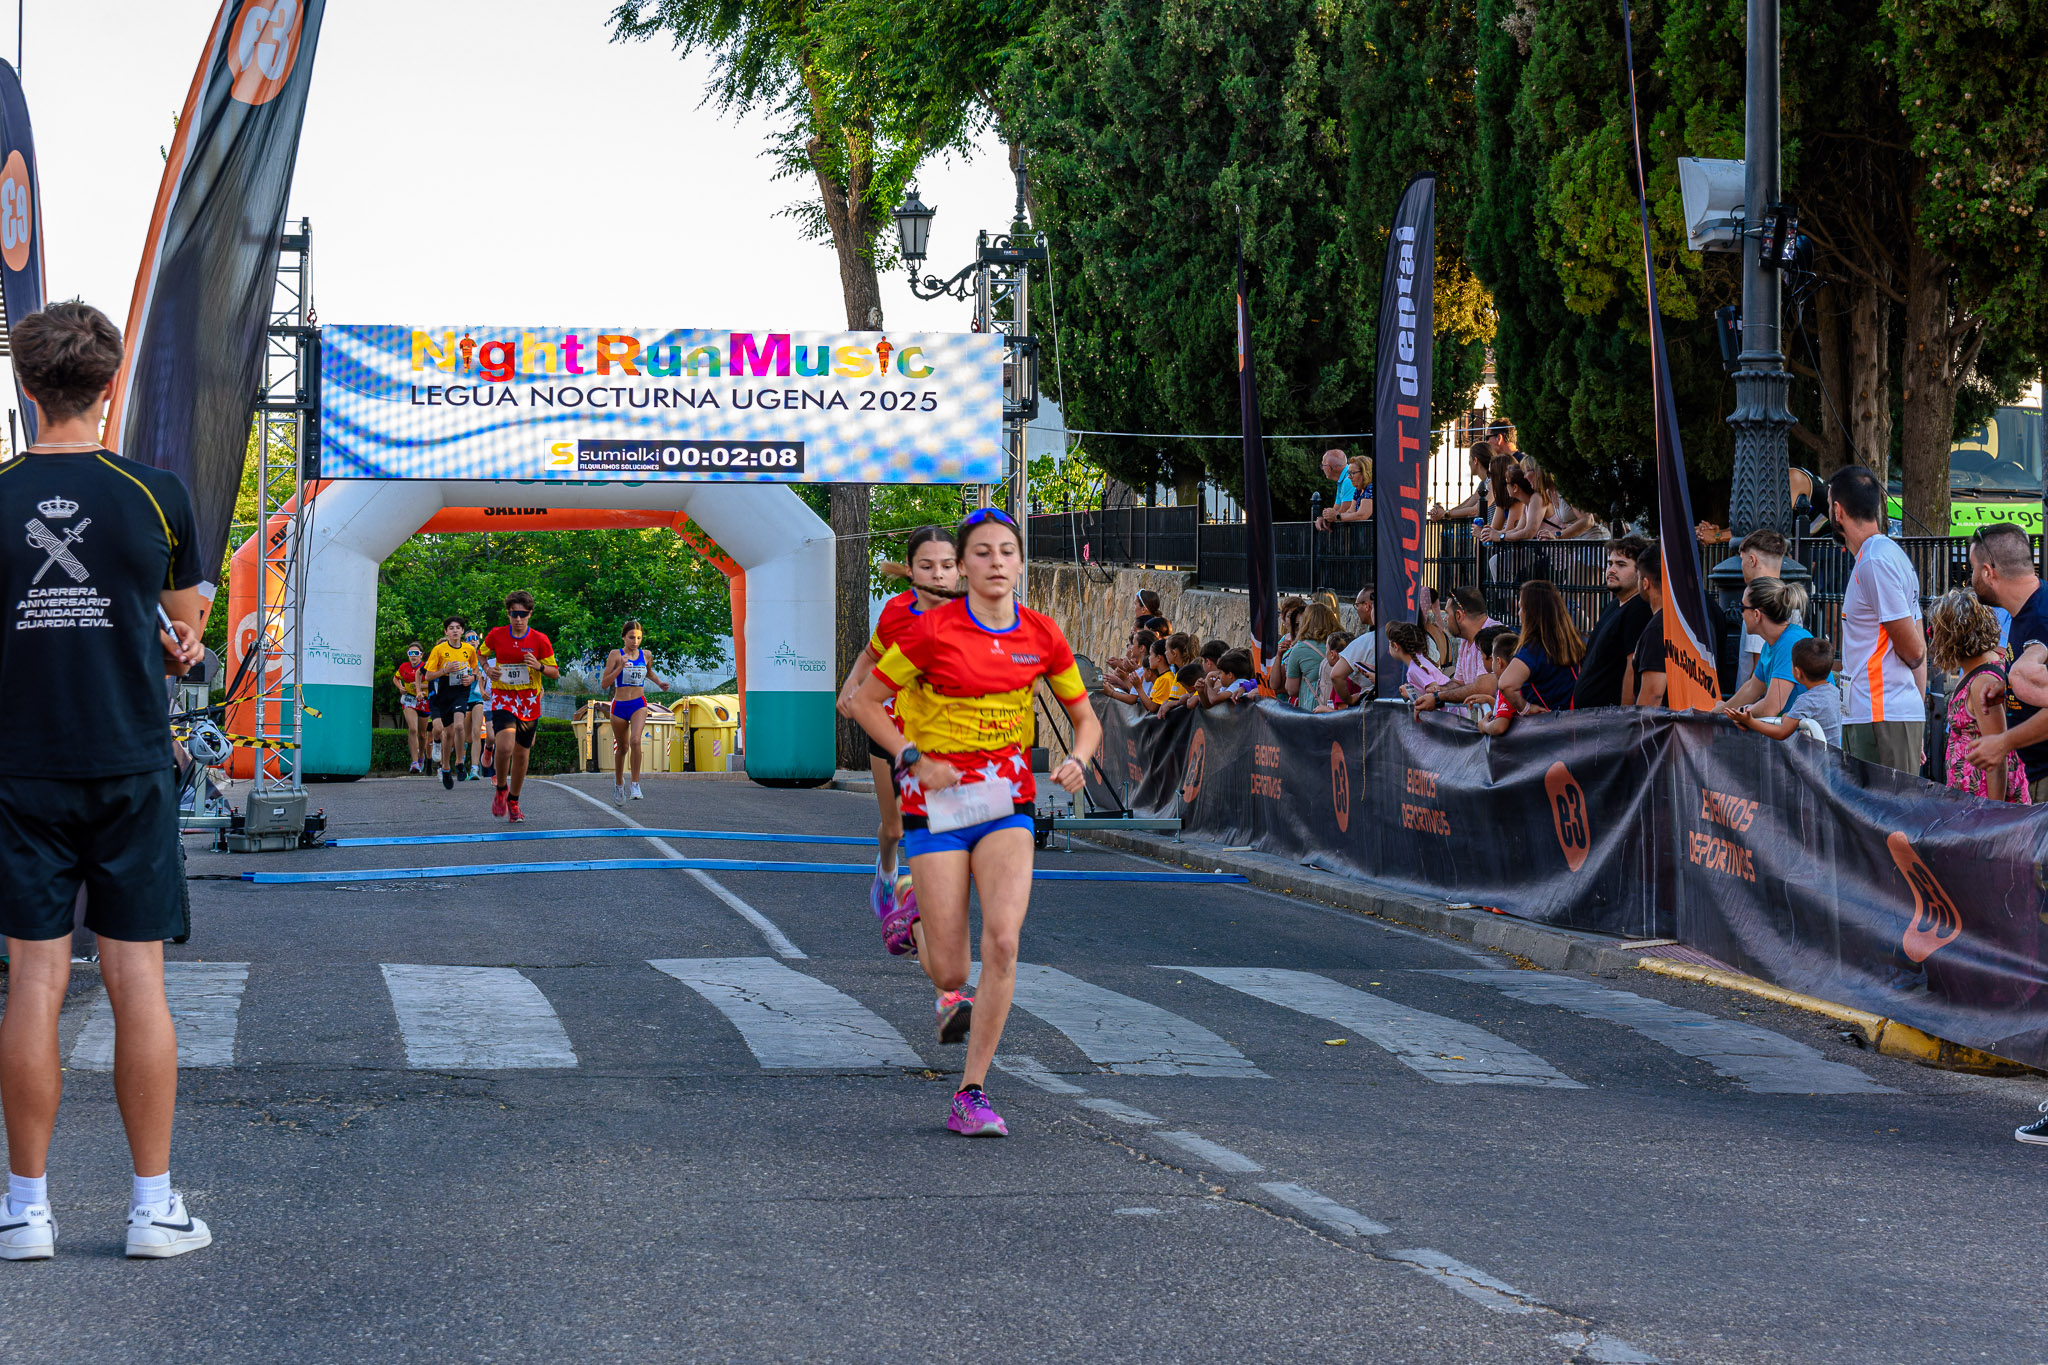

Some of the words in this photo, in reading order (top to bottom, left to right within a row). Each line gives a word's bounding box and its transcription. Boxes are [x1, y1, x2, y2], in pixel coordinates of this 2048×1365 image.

[411, 385, 518, 407] LEGUA
[530, 386, 720, 409] NOCTURNA
[732, 388, 849, 410] UGENA
[859, 390, 938, 412] 2025
[580, 448, 660, 461] sumialki
[662, 447, 797, 467] 00:02:08
[1397, 403, 1420, 611] MULTI
[27, 587, 98, 598] CARRERA
[16, 597, 111, 610] ANIVERSARIO
[24, 607, 104, 619] FUNDACIÓN
[16, 619, 77, 630] GUARDIA
[78, 618, 114, 628] CIVIL
[332, 657, 362, 666] TOLEDO
[800, 664, 826, 672] TOLEDO
[508, 670, 520, 679] 497
[1255, 744, 1281, 768] EVENTOS
[1250, 773, 1282, 799] DEPORTIVOS
[1406, 768, 1439, 798] EVENTOS
[1401, 803, 1451, 836] DEPORTIVOS
[1701, 788, 1758, 832] EVENTOS
[1688, 830, 1756, 882] DEPORTIVOS
[135, 1209, 151, 1217] NIKE
